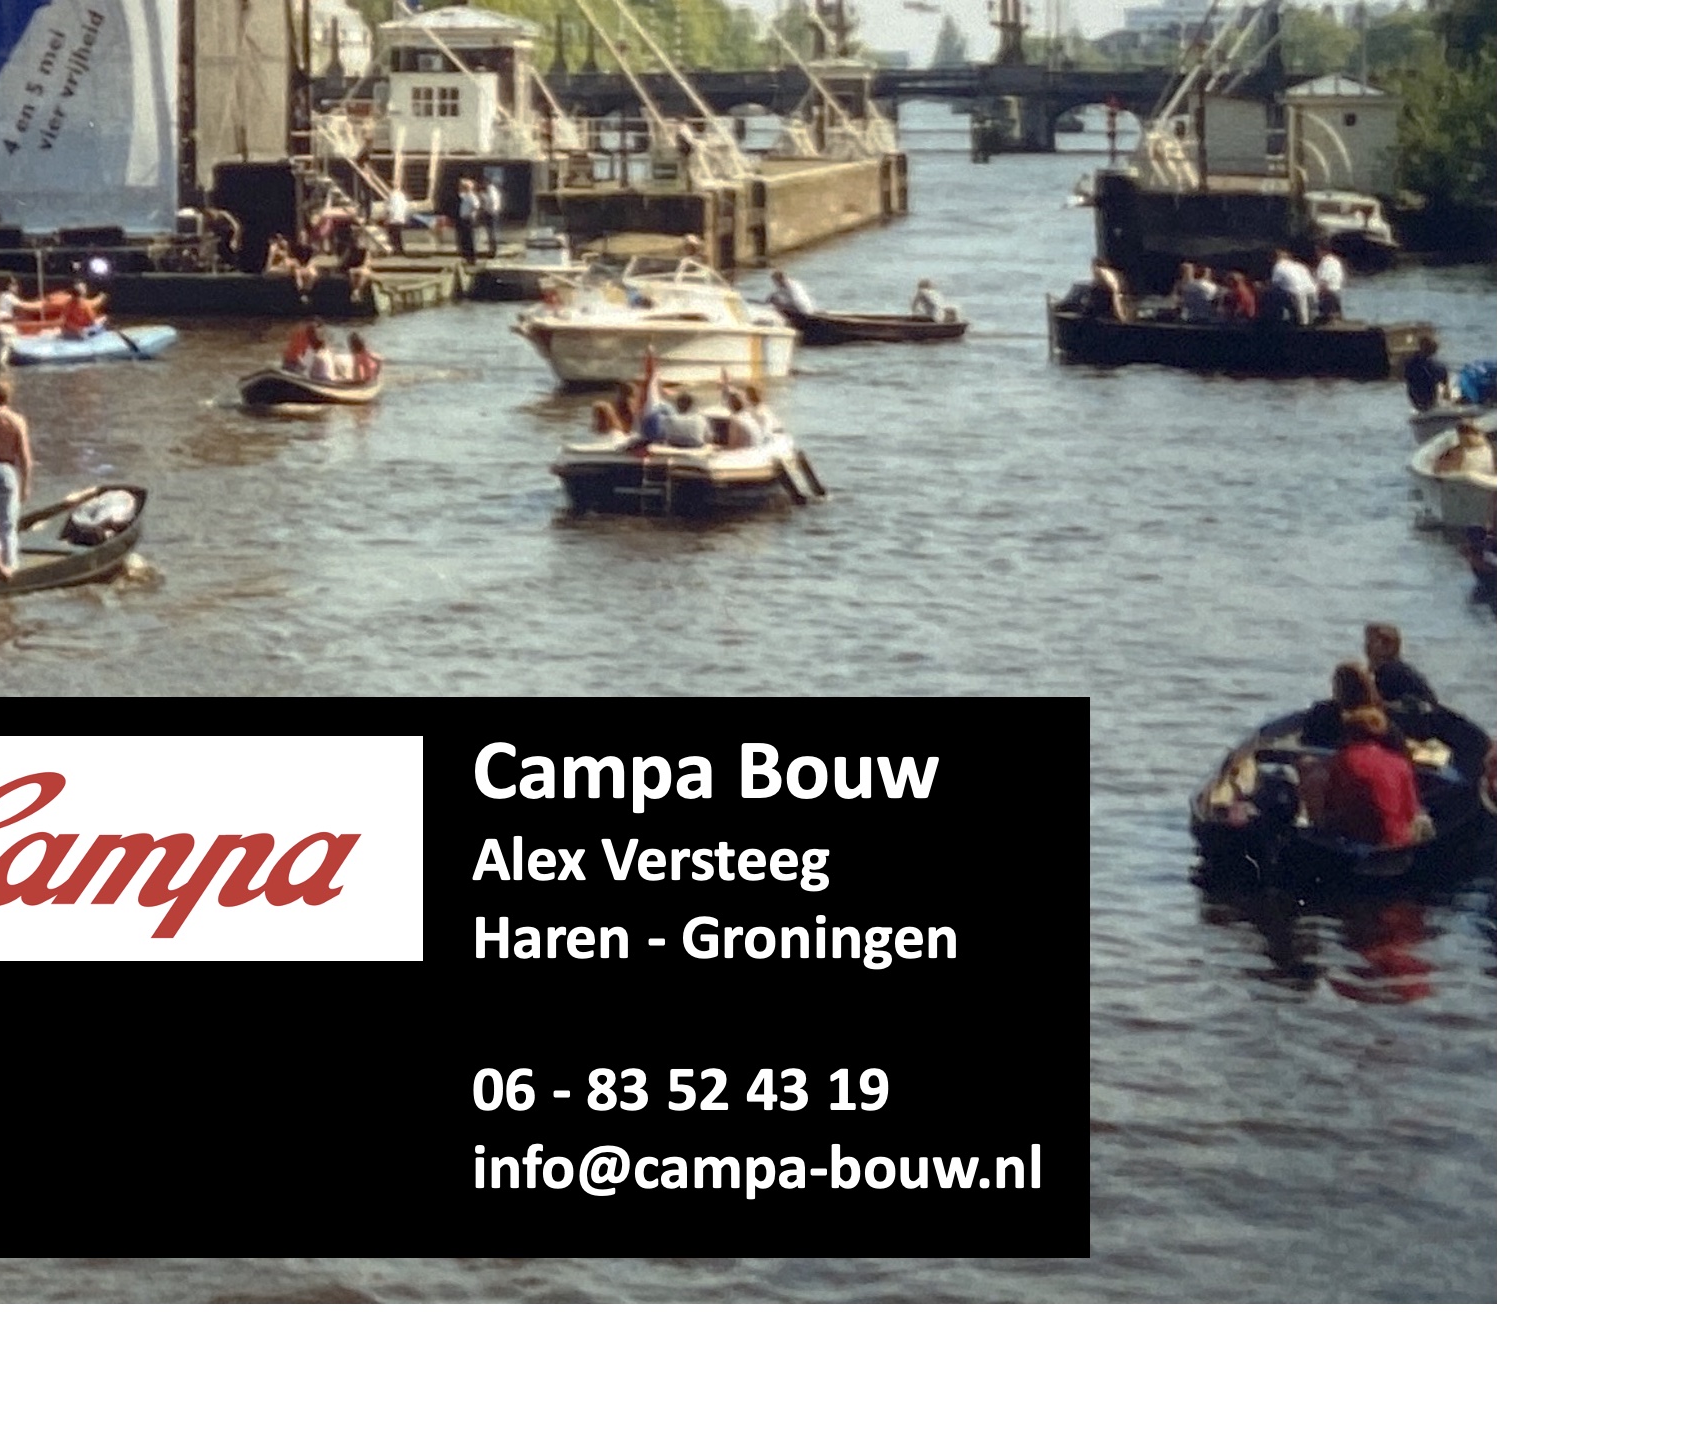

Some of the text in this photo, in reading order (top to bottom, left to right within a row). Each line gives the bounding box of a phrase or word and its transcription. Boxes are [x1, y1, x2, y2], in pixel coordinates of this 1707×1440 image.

[3, 28, 65, 155] 4 en 5 mei
[39, 9, 106, 150] vier vrijheid
